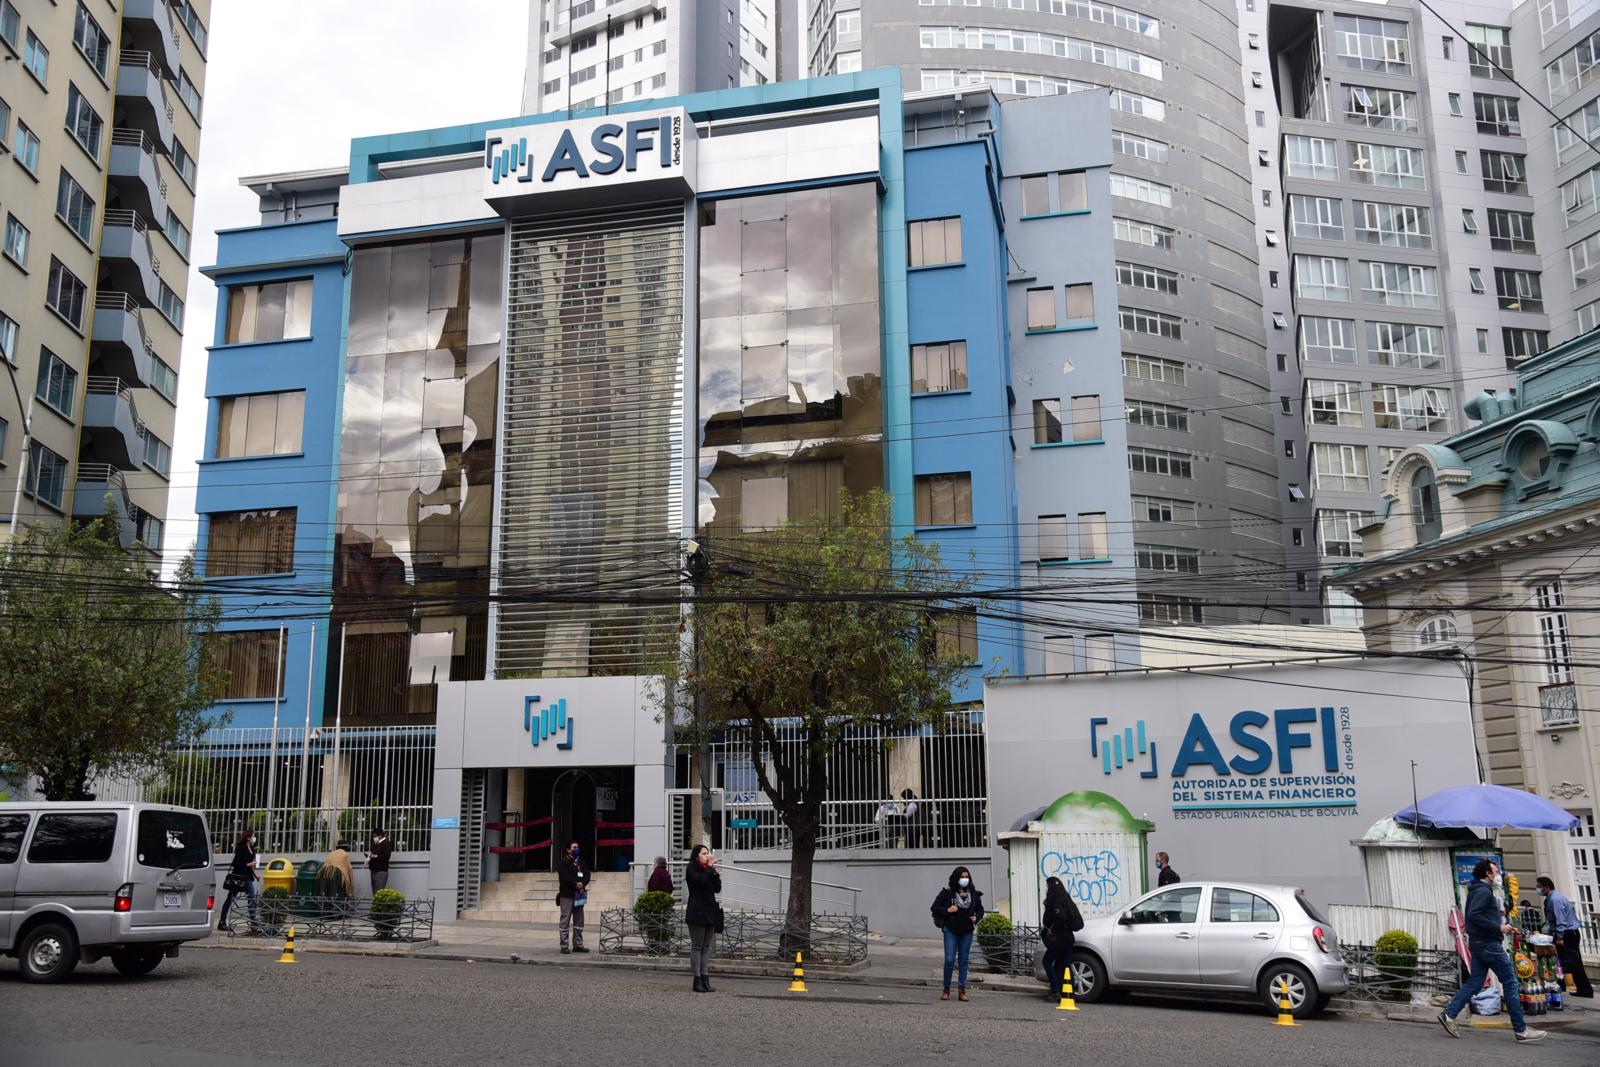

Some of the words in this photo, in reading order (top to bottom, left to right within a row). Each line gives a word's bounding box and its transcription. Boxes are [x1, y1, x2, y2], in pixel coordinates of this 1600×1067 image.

[673, 116, 681, 136] 1928
[541, 116, 672, 182] ASFI
[673, 137, 681, 165] desde
[1340, 706, 1351, 731] 1928
[1171, 707, 1339, 777] ASFI
[1344, 734, 1354, 770] desde
[1172, 779, 1247, 790] AUTORIDAD
[1250, 778, 1267, 788] DE
[1269, 772, 1356, 787] SUPERVISIÓN
[1172, 791, 1198, 802] DEL
[1203, 790, 1264, 801] SISTEMA
[1269, 788, 1356, 800] FINANCIERO
[1174, 811, 1213, 820] ESTADO
[1214, 809, 1297, 819] PLURINACIONAL
[1300, 809, 1314, 818] DE
[1316, 808, 1359, 817] BOLIVIA
